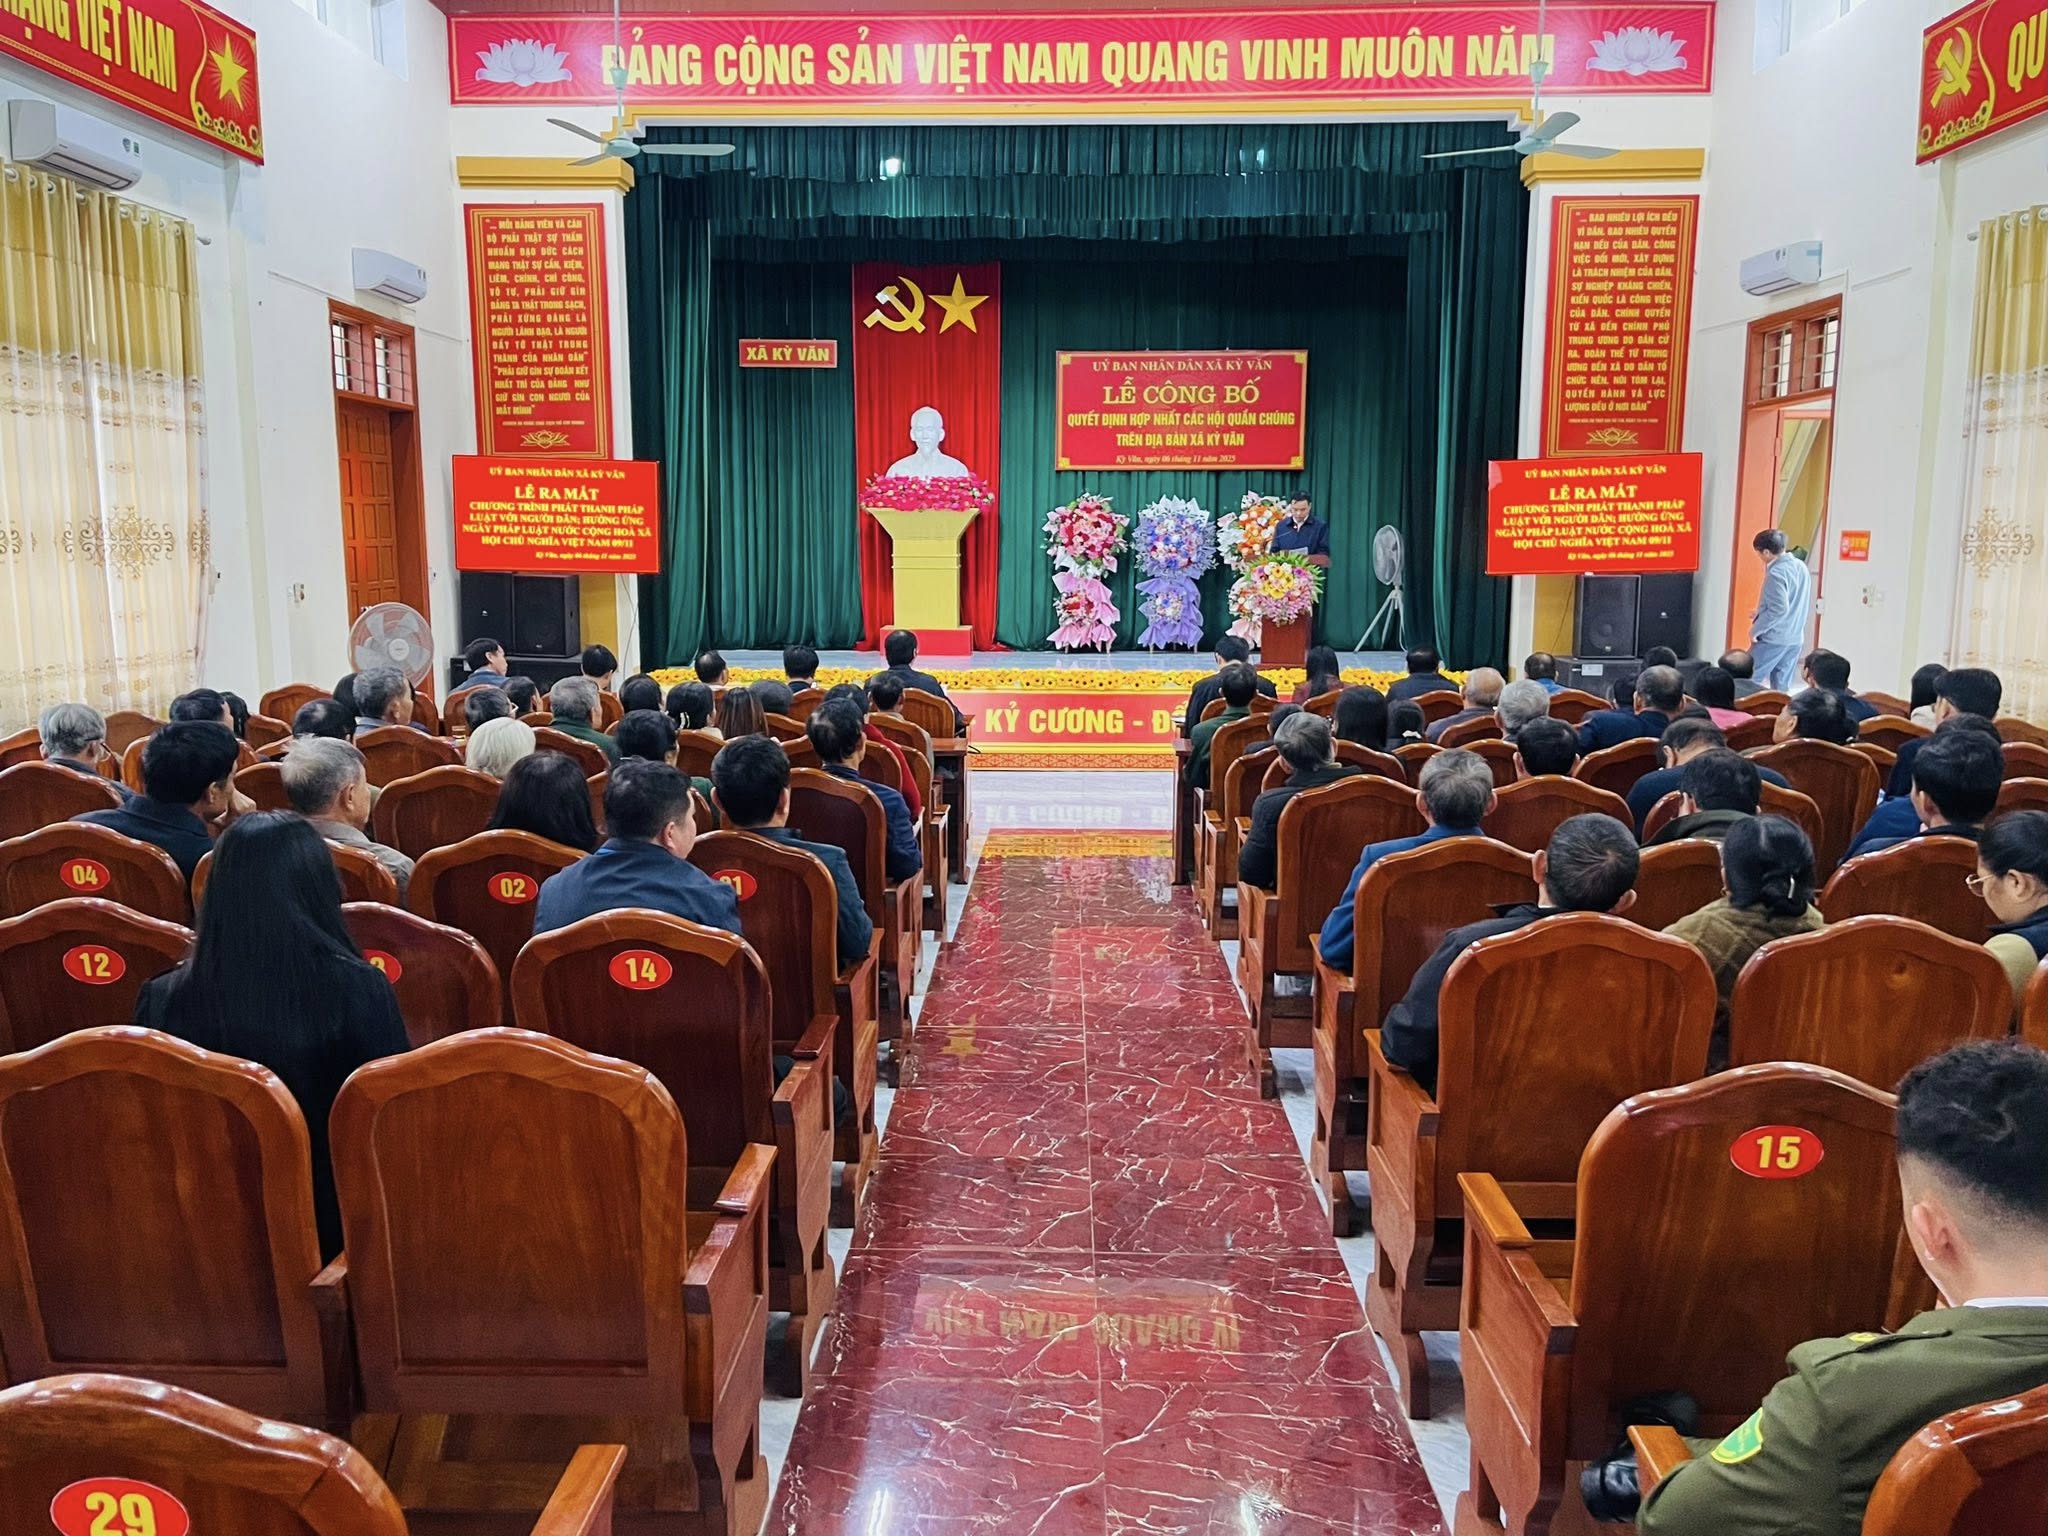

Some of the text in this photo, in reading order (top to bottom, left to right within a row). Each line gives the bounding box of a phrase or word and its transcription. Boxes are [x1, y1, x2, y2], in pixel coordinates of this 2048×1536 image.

[127, 6, 177, 92] NAM
[602, 25, 1554, 94] ĐẢNG CỘNG SẢN VIỆT NAM QUANG VINH MUÔN NĂM
[746, 344, 830, 361] XÃ KỲ VĂN
[1113, 362, 1137, 371] BAN
[1140, 359, 1174, 371] NHÂN
[1178, 359, 1202, 370] DÂN
[1206, 359, 1222, 370] XÃ
[1247, 359, 1271, 370] VĂN
[1103, 376, 1260, 405] LỄ CÔNG BỐ
[1068, 411, 1100, 427] QUYẾT
[1102, 414, 1127, 428] ĐỊNH
[1130, 412, 1151, 428] HỢP
[1153, 410, 1181, 426] NHẤT
[1184, 411, 1204, 426] CÁC
[1207, 411, 1224, 428] HỘI
[1259, 410, 1294, 424] CHÚNG
[1116, 431, 1244, 448] TRÊN ĐỊA BÀN XÃ KỲ VĂN
[515, 484, 599, 500] LỄ RA MẮT
[1550, 483, 1637, 500] LỄ RA MẮT
[984, 701, 1020, 733] KỶ
[1029, 706, 1124, 734] CƯƠNG
[72, 865, 98, 885] 04
[500, 878, 526, 898] 02
[79, 952, 111, 977] 12
[625, 957, 657, 982] 14
[1756, 1135, 1801, 1169] 15
[85, 1491, 157, 1536] 29
